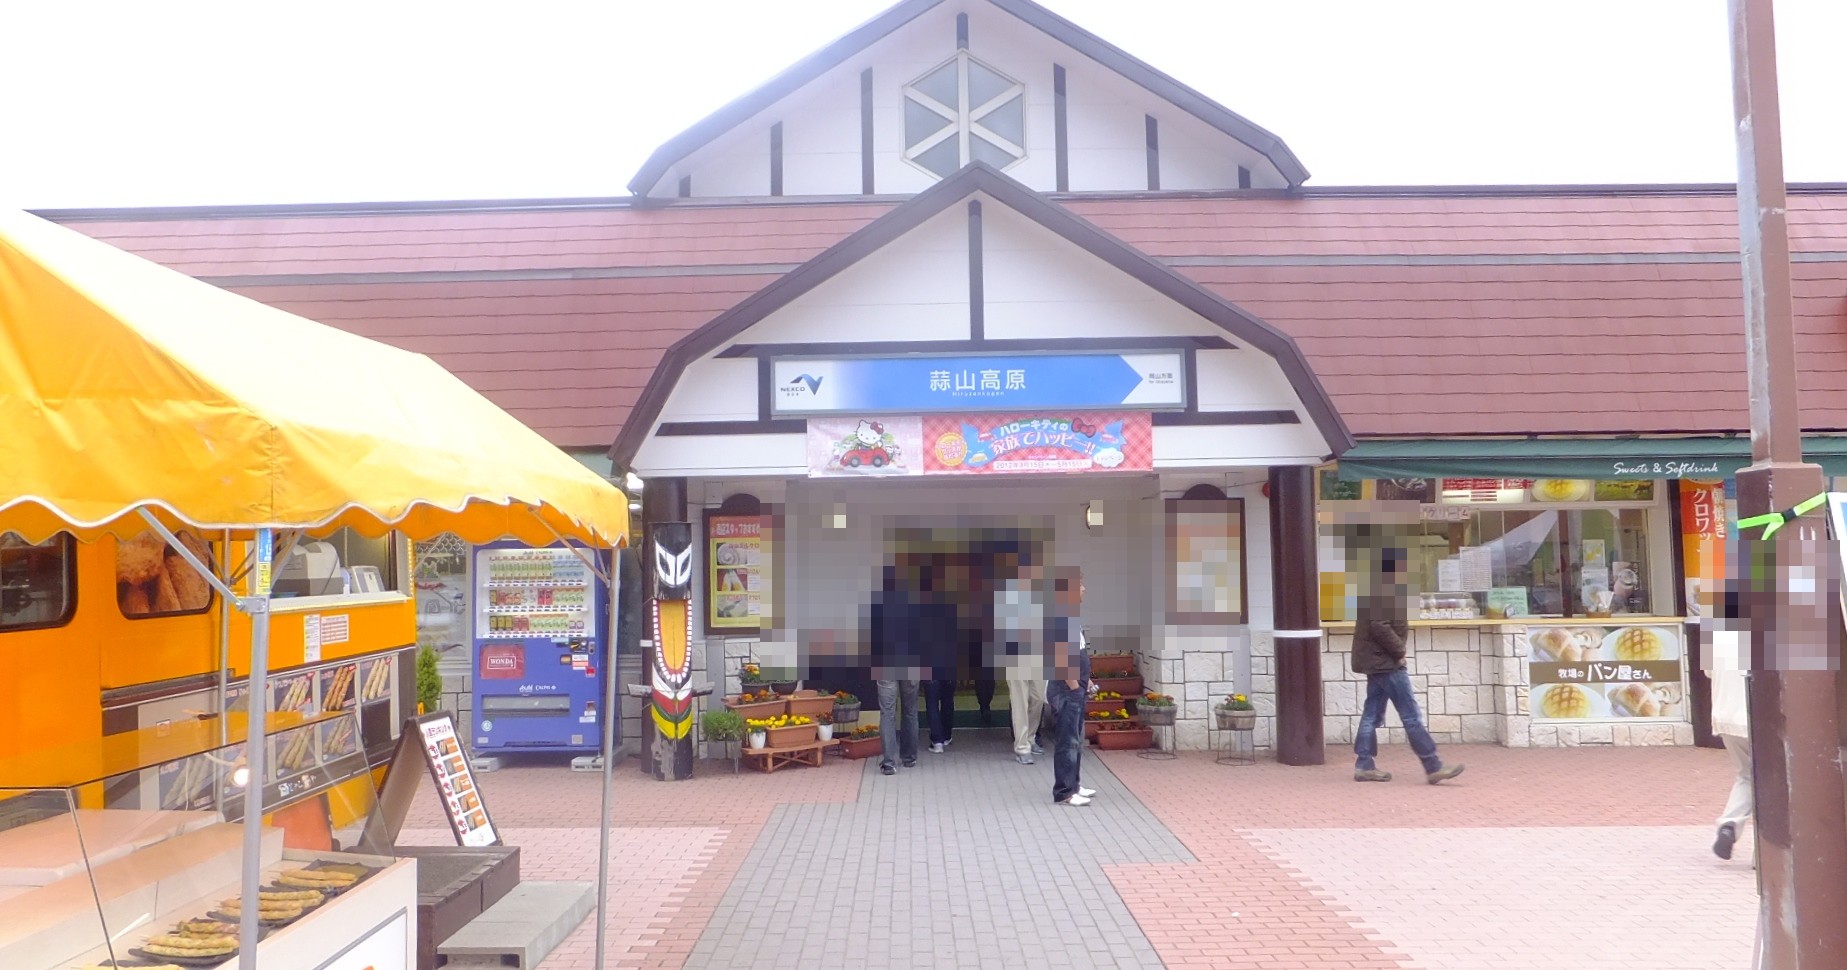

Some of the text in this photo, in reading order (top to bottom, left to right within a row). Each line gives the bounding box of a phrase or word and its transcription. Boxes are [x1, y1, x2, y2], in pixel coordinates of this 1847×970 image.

[929, 369, 1026, 391] 蒜山高原
[1000, 419, 1068, 436] ハローキティの
[1613, 461, 1718, 477] Sweets & Softdrink
[1558, 663, 1652, 681] 牧場のパン屋さん
